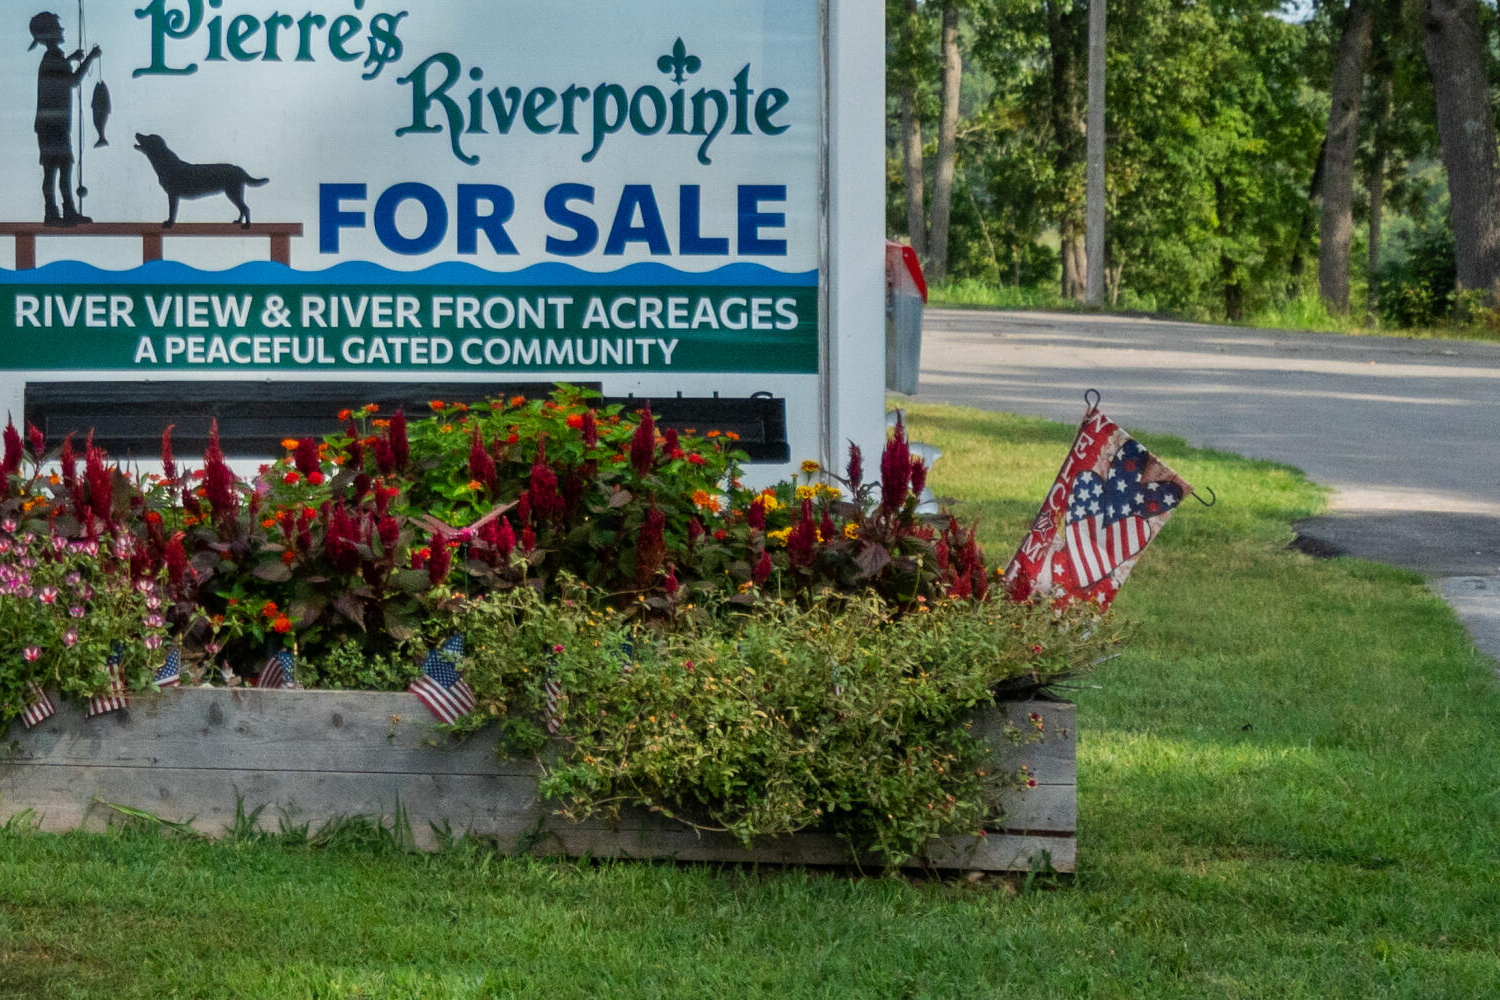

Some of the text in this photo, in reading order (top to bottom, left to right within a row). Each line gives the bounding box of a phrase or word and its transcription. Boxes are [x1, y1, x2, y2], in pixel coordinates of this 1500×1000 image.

[394, 52, 792, 166] Riverpointe
[319, 182, 788, 257] FOR SALE
[15, 295, 799, 330] RIVER VIEW & RIVER FRONT ACREAGES
[134, 336, 679, 365] A PEACEFUL GATED COMMUNITY
[1004, 413, 1112, 581] WELCM
